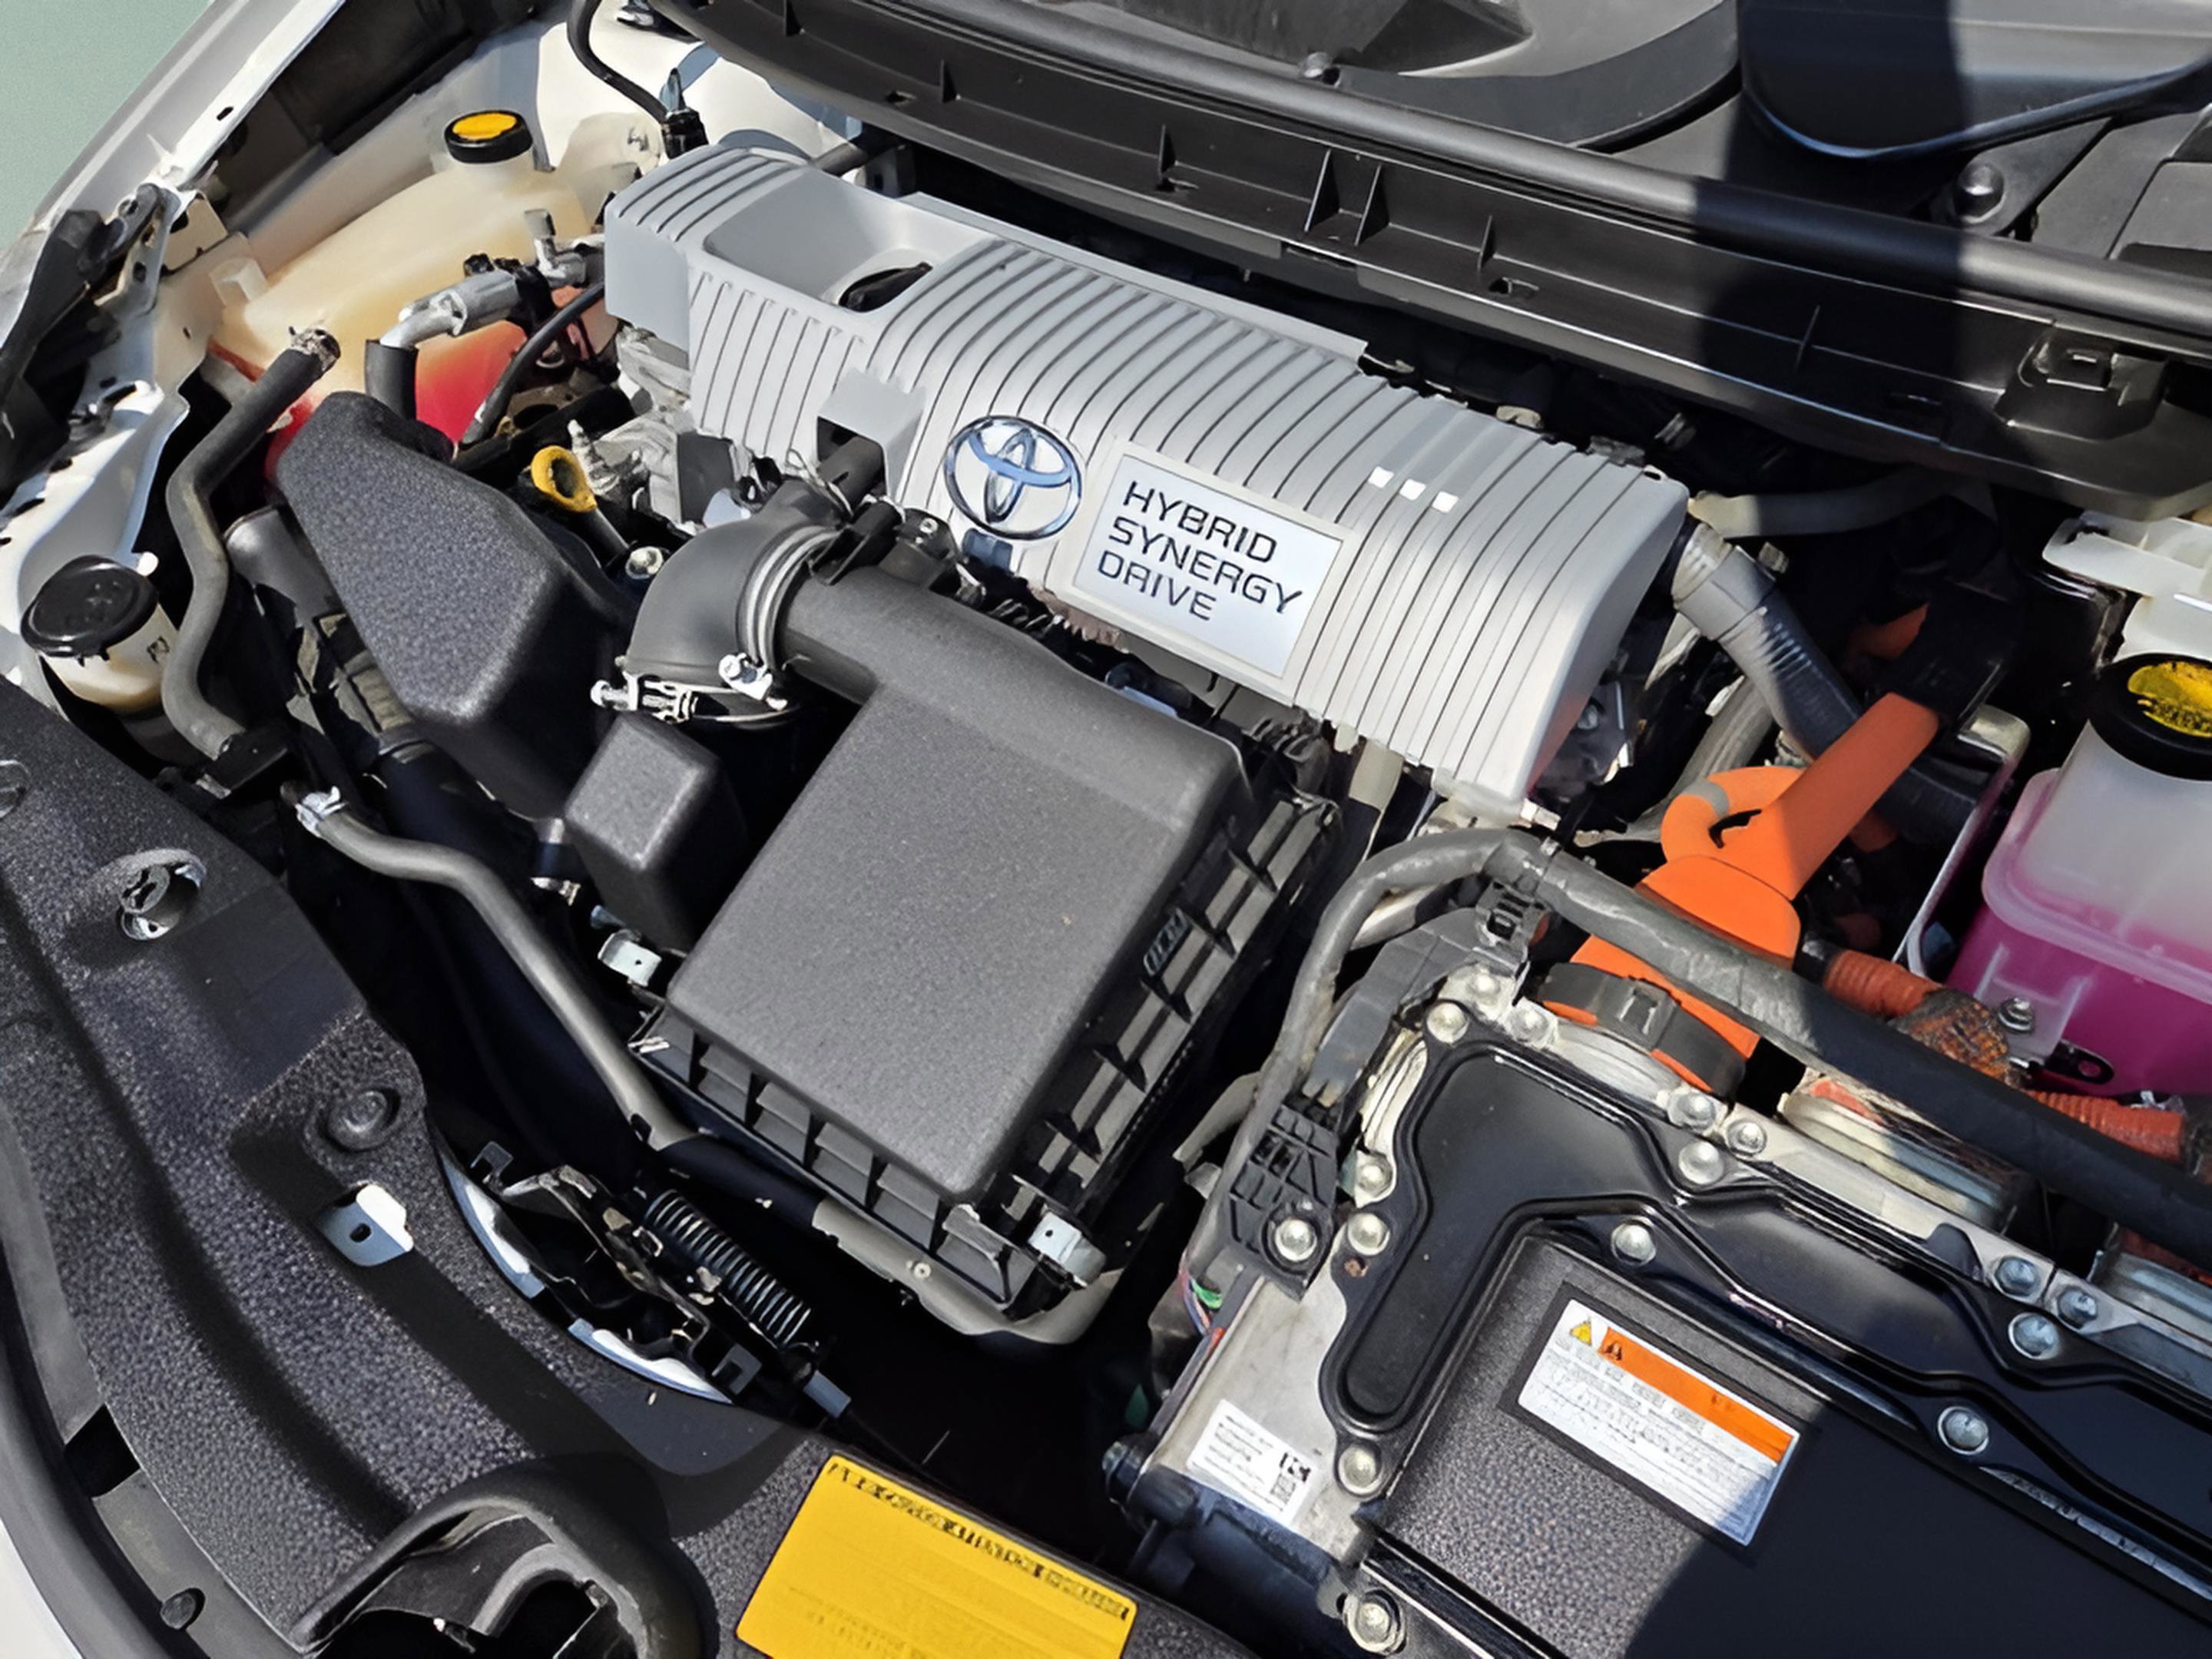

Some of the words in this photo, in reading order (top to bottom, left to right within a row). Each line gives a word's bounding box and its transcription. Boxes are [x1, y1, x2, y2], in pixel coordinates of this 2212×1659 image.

[1122, 480, 1277, 564] HYBRID
[1098, 549, 1217, 621] DRIVE
[1108, 515, 1303, 614] SYNERGY
